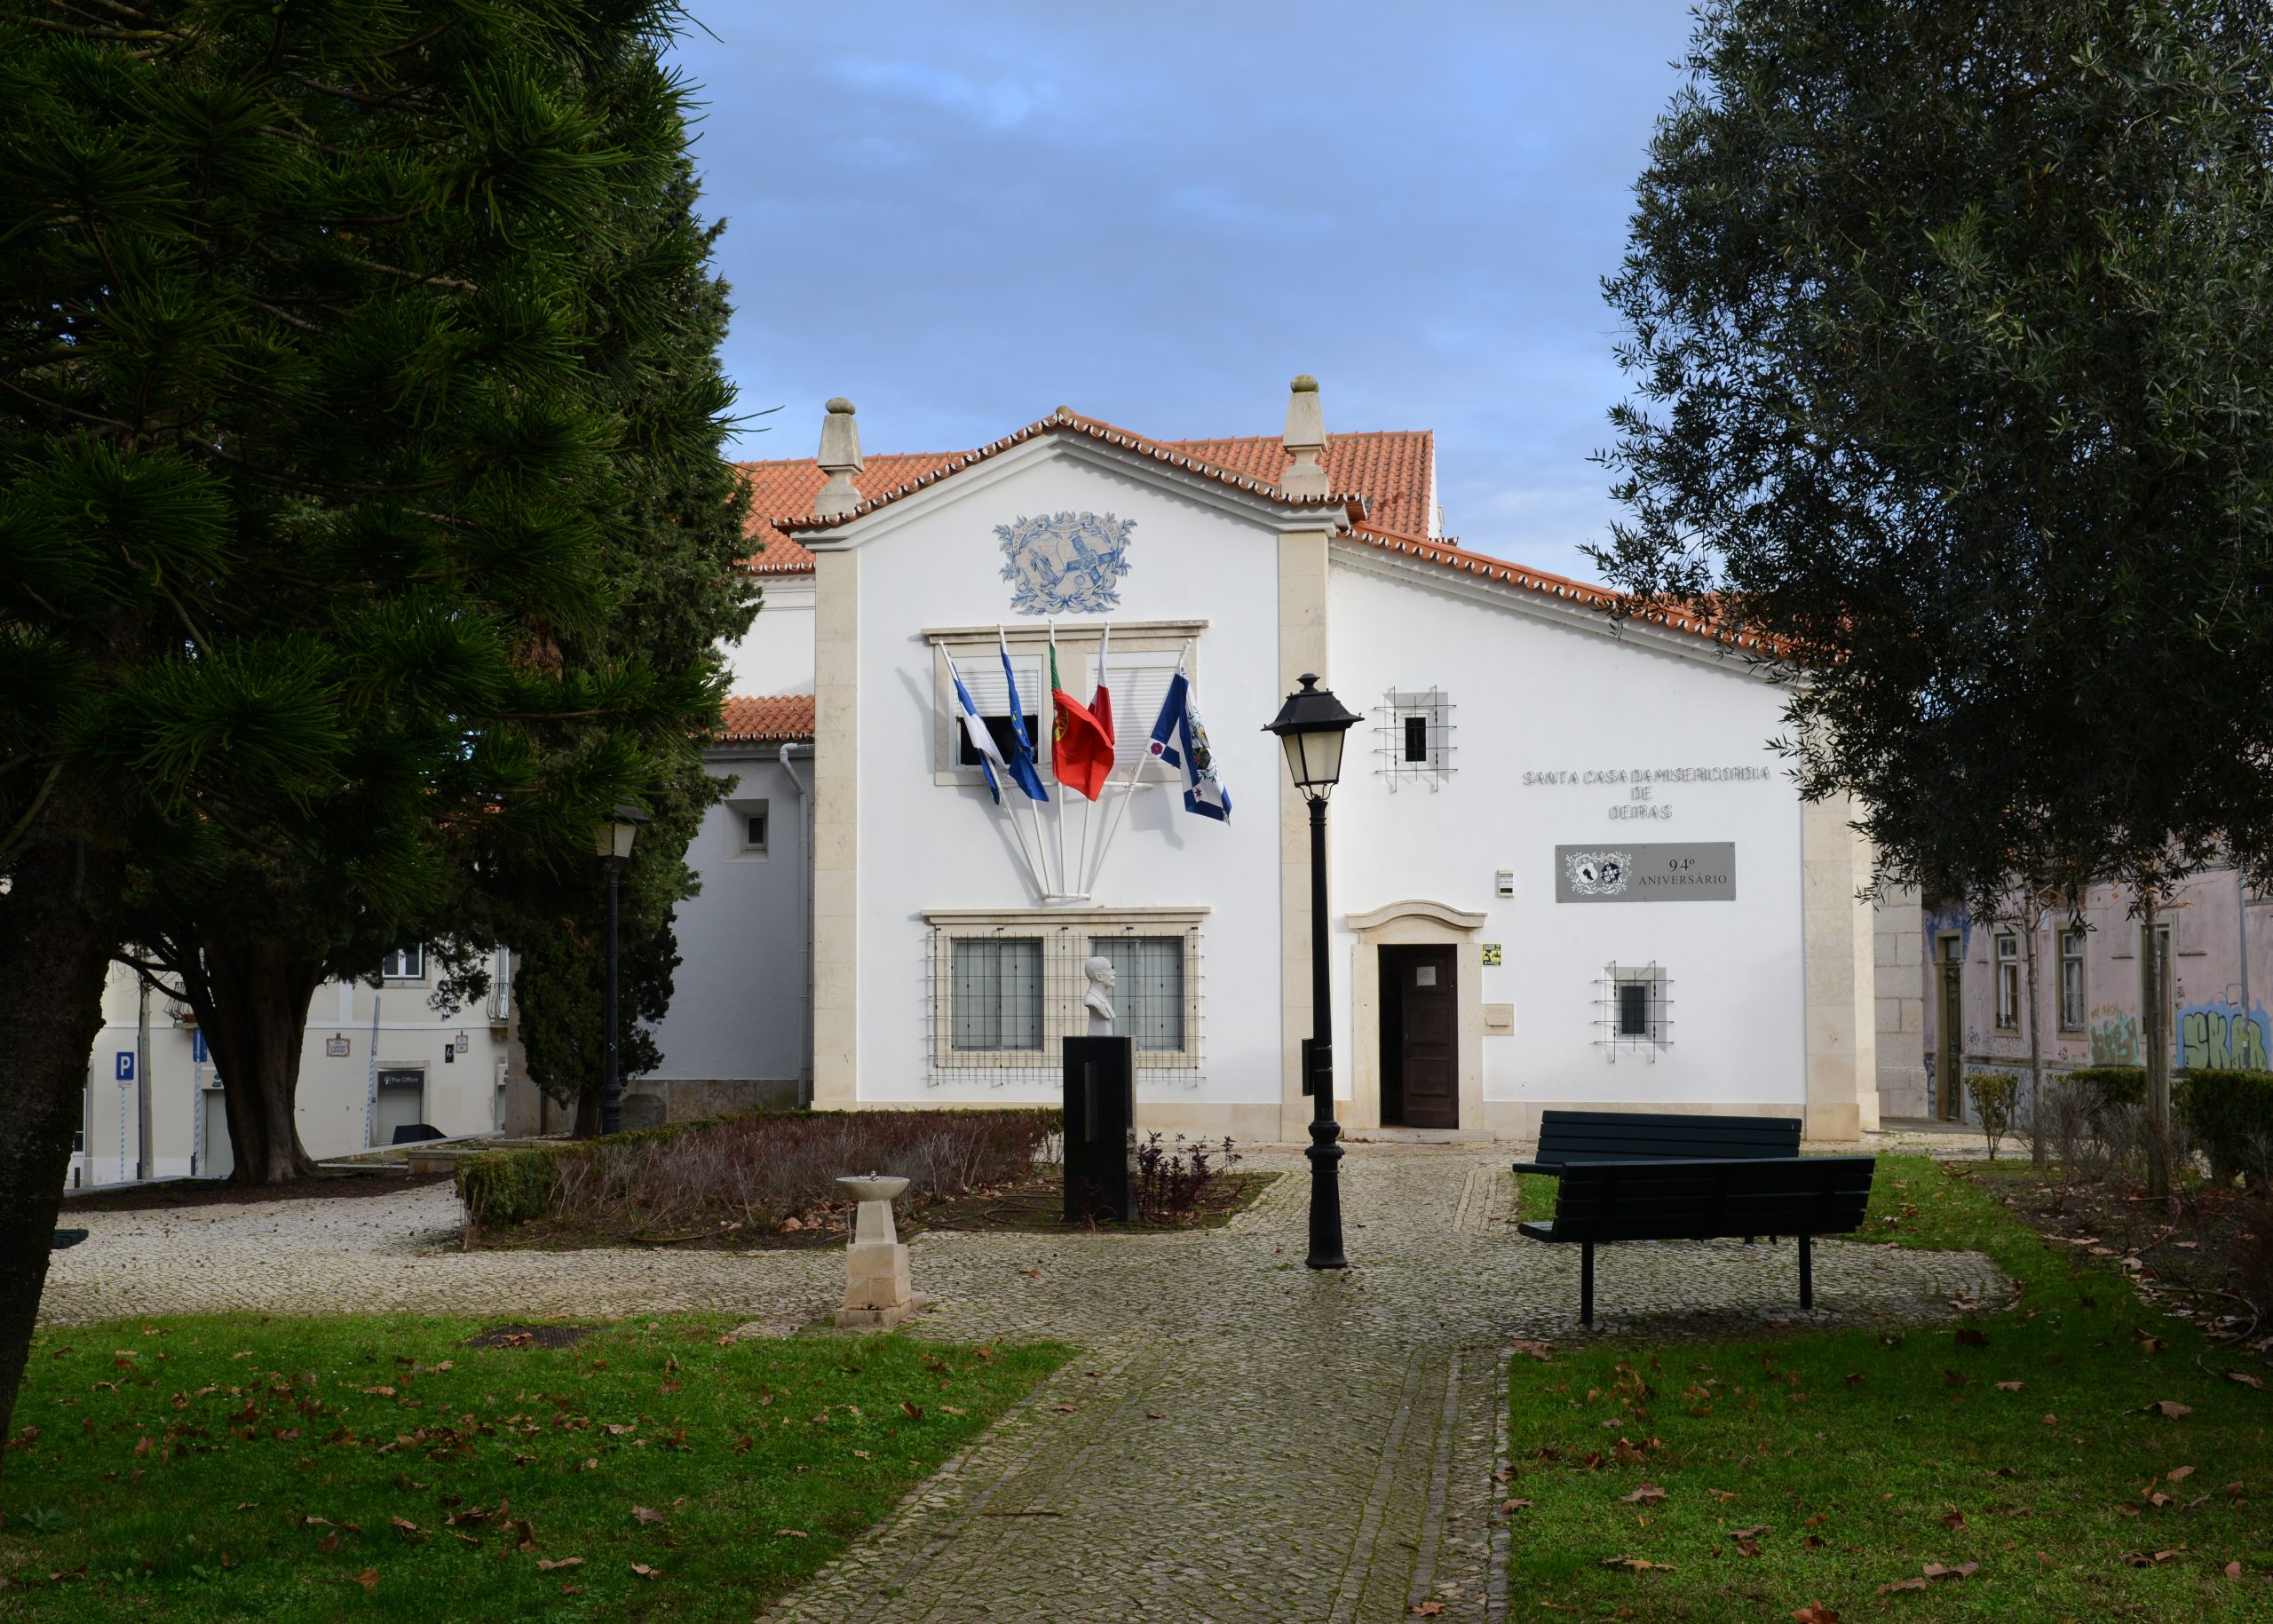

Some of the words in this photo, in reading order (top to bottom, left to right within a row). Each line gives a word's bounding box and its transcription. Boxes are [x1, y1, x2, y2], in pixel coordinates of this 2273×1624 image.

[1524, 770, 1580, 785] SANTA
[1584, 769, 1629, 784] CASA
[1632, 769, 1654, 783] DA
[1657, 766, 1770, 782] MISERICORDIA
[1632, 786, 1653, 800] DE
[1610, 804, 1673, 820] OEIRAS
[1638, 873, 1727, 885] ANIVERSÁRIO
[120, 1056, 131, 1076] P
